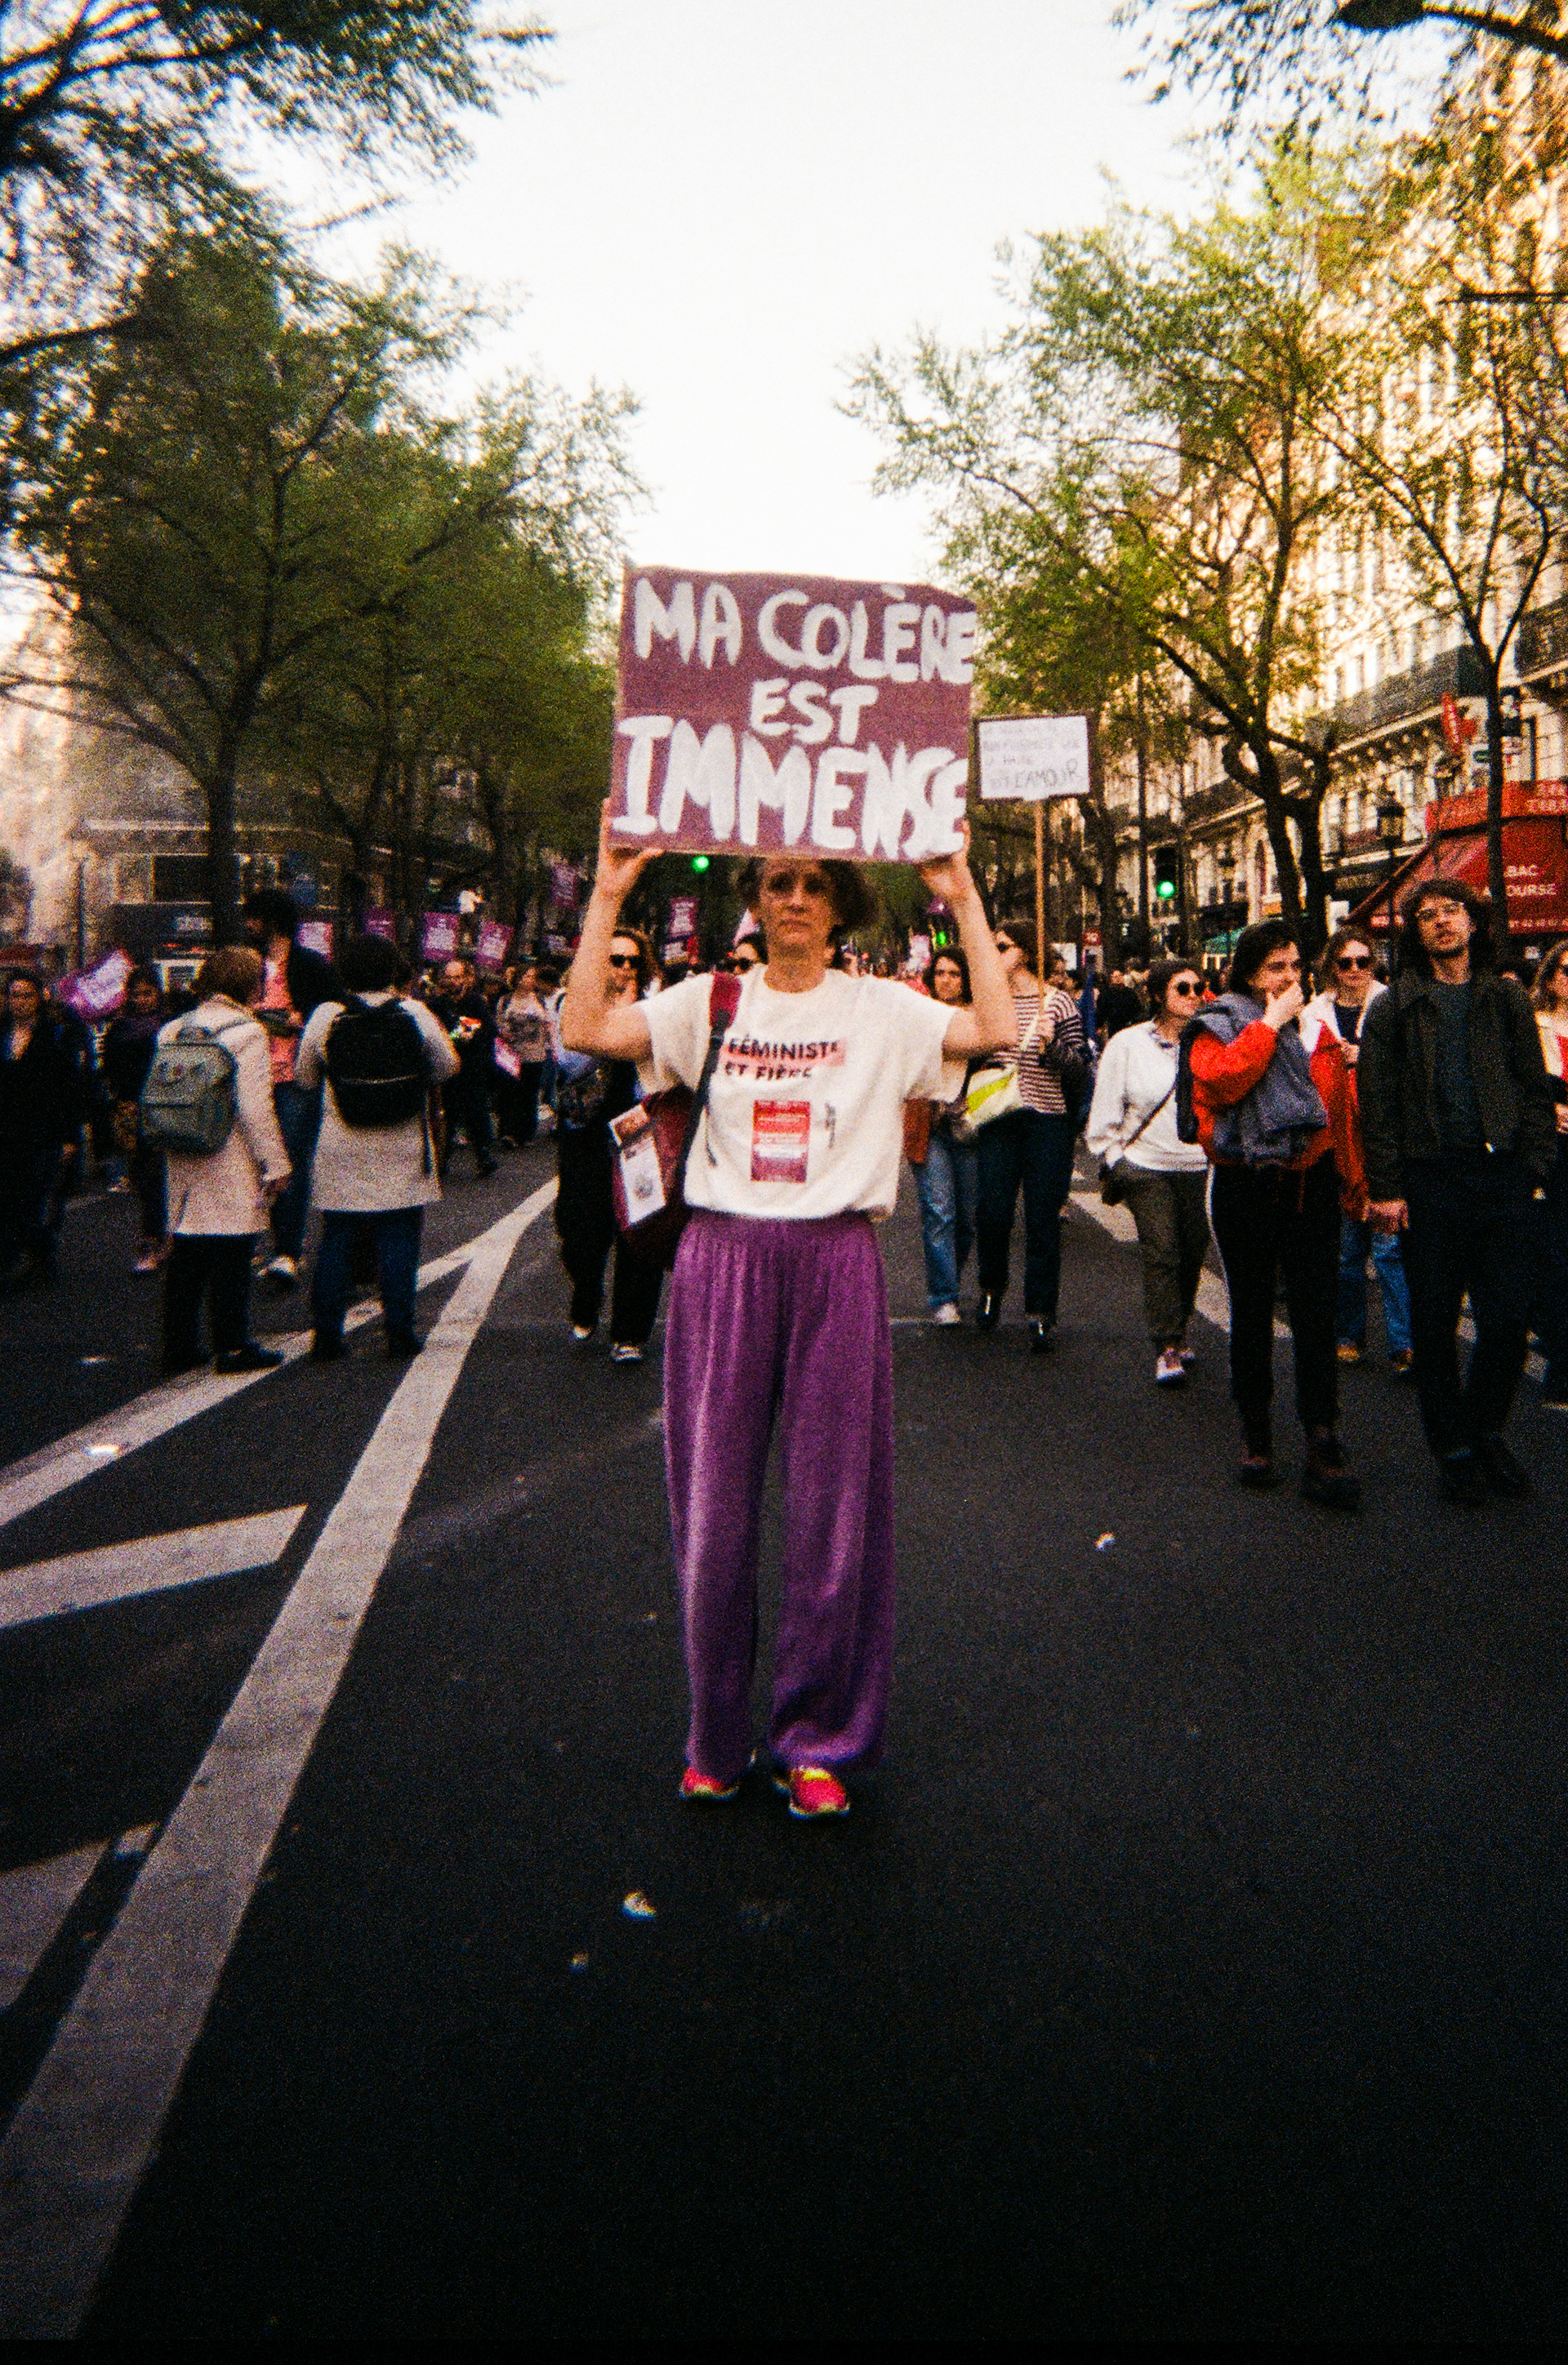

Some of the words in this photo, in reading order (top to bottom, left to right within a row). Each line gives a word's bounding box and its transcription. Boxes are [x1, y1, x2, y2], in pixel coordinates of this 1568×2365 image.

[634, 577, 742, 669] MA
[757, 584, 978, 684] COLÈRE
[751, 677, 879, 744] EST
[612, 715, 969, 860] IMMENSE
[1503, 864, 1539, 878] BAC
[1505, 883, 1557, 897] OURSE
[724, 1061, 748, 1076] ET
